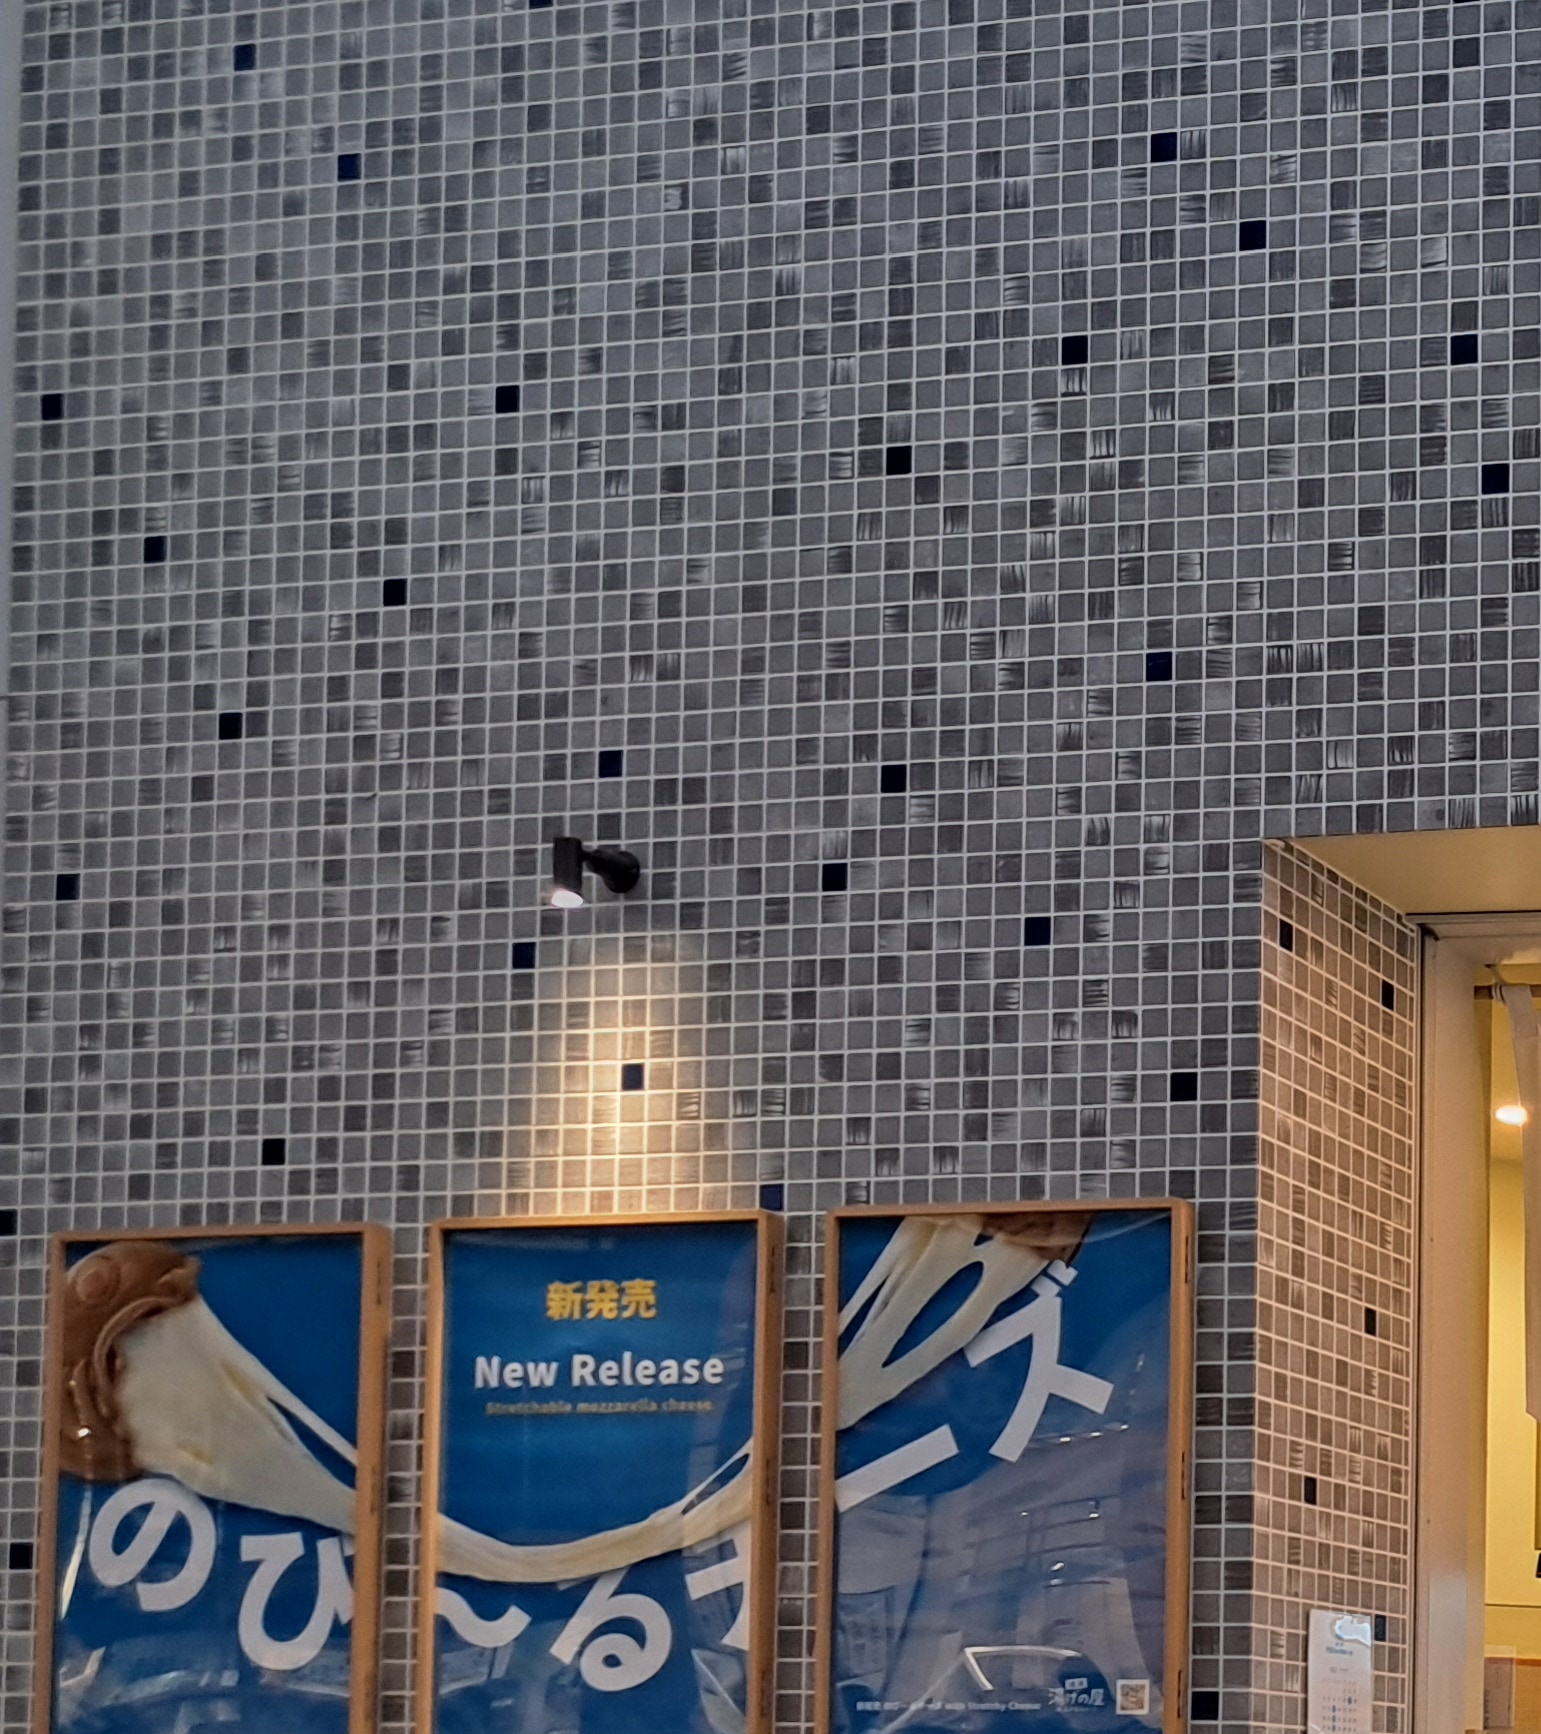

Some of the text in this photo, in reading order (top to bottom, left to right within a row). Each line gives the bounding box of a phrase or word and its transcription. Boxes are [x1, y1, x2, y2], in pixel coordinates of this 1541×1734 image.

[547, 1278, 657, 1321] 新発売
[474, 1350, 725, 1390] New Release
